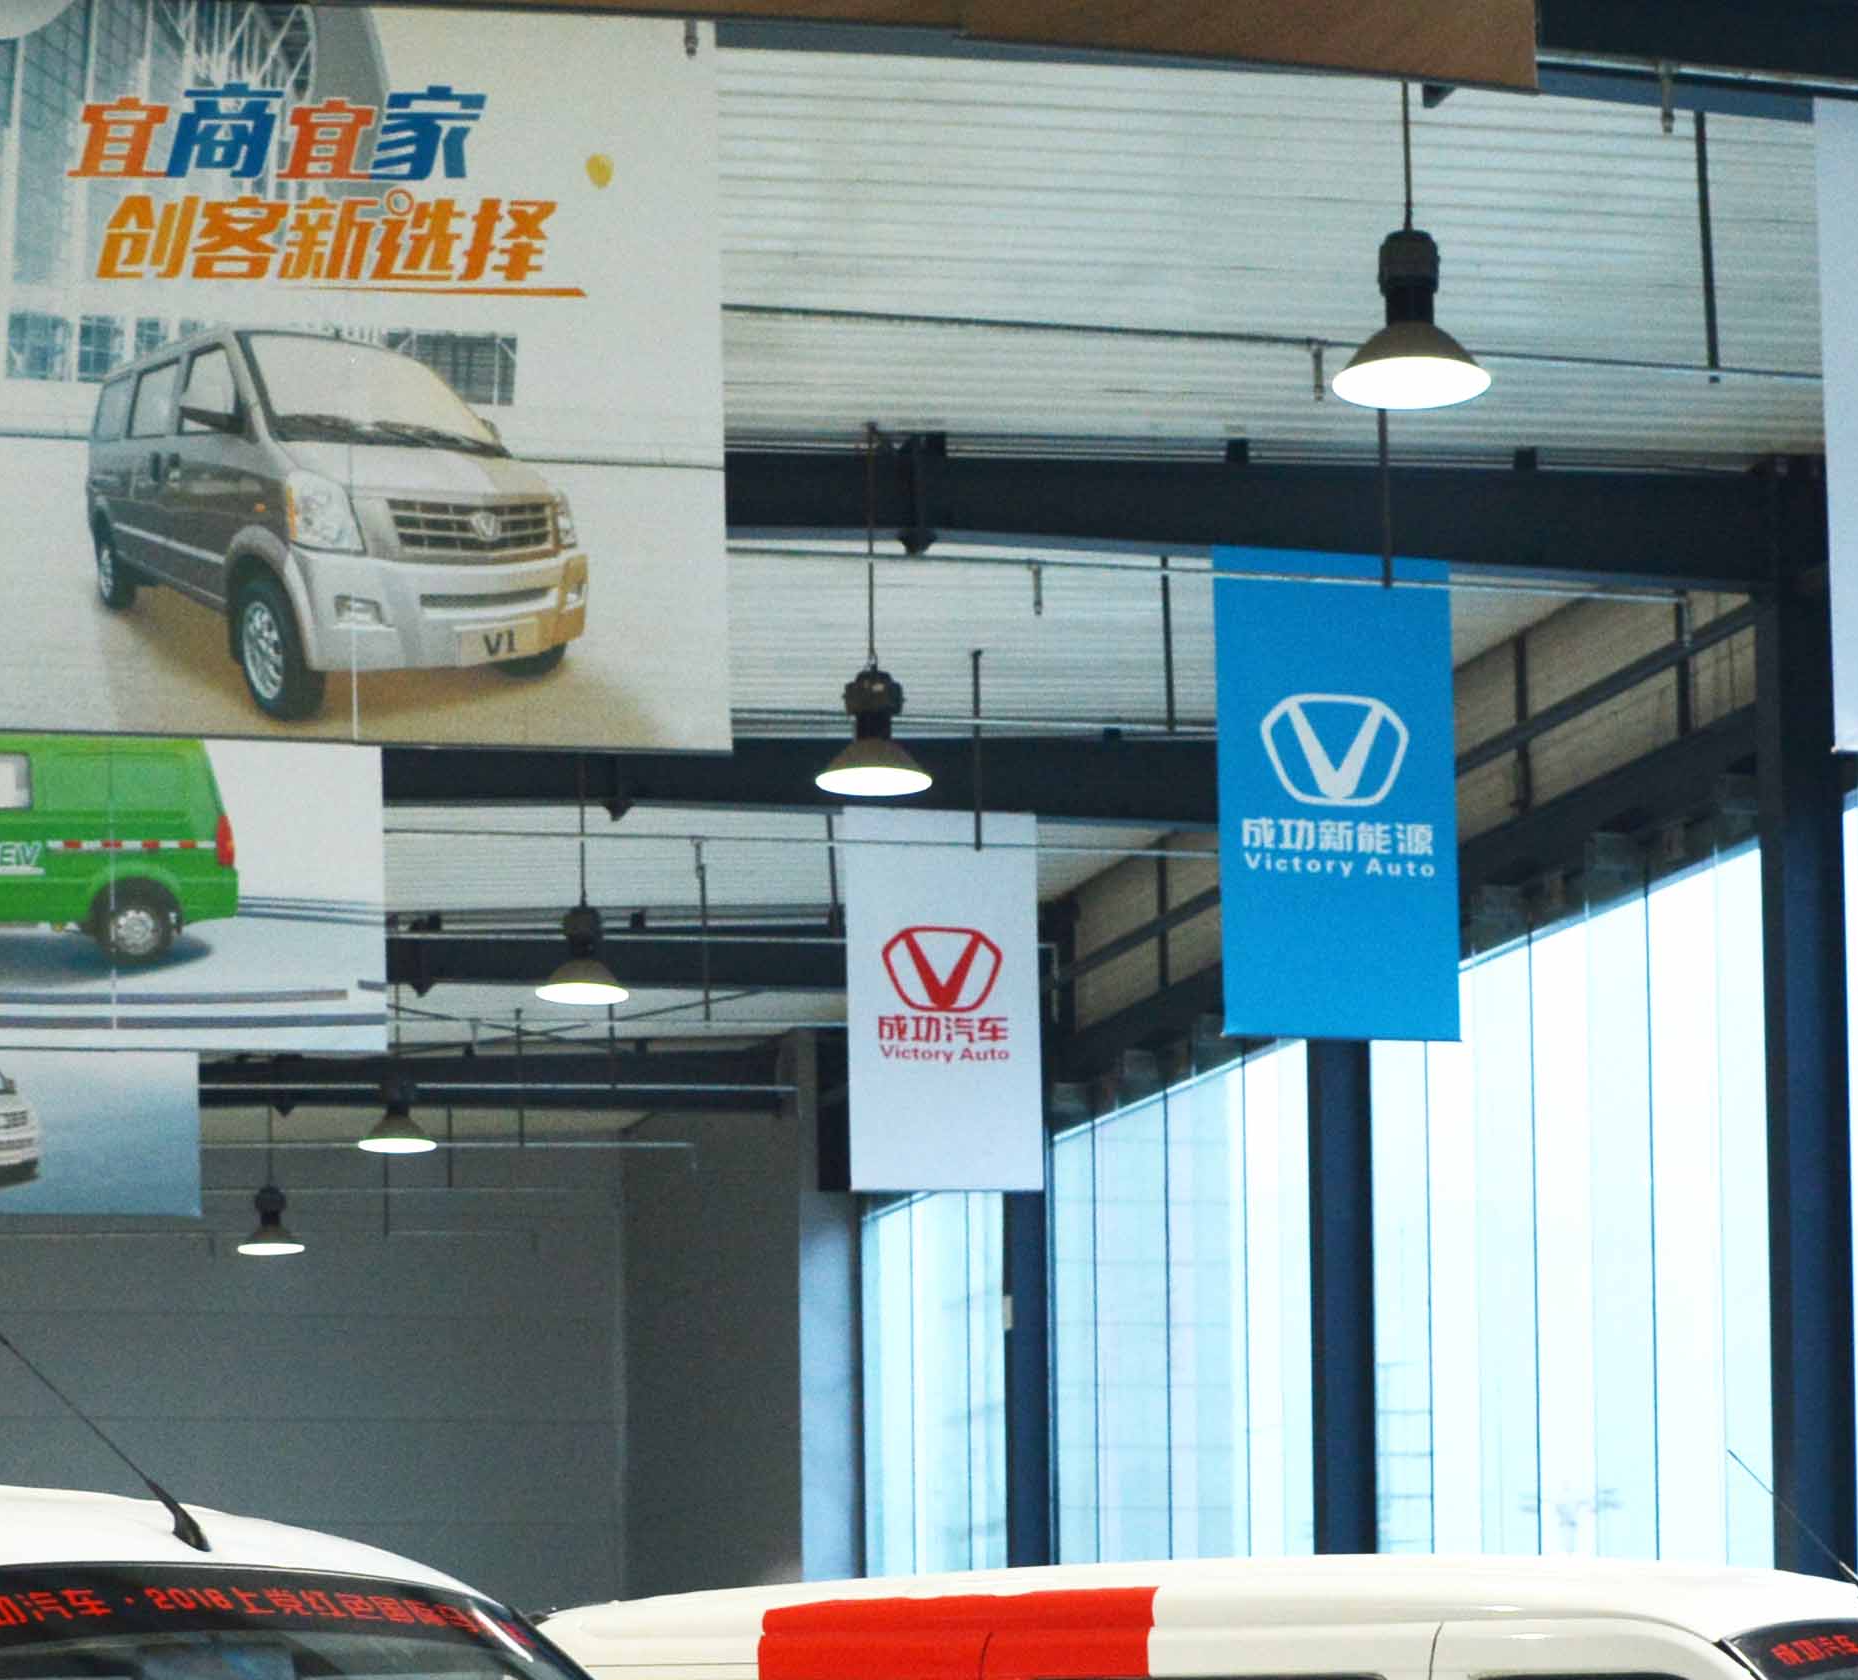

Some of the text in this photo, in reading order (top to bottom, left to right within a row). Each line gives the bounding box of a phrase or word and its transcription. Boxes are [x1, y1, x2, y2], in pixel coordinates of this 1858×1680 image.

[67, 82, 488, 181] 宜商宜家
[96, 192, 558, 284] 创客新选择
[1242, 818, 1434, 856] 成功新能源
[1244, 853, 1435, 877] Victory Auto
[878, 1016, 1008, 1042] 成功汽车
[880, 1044, 1009, 1063] Victory Auto
